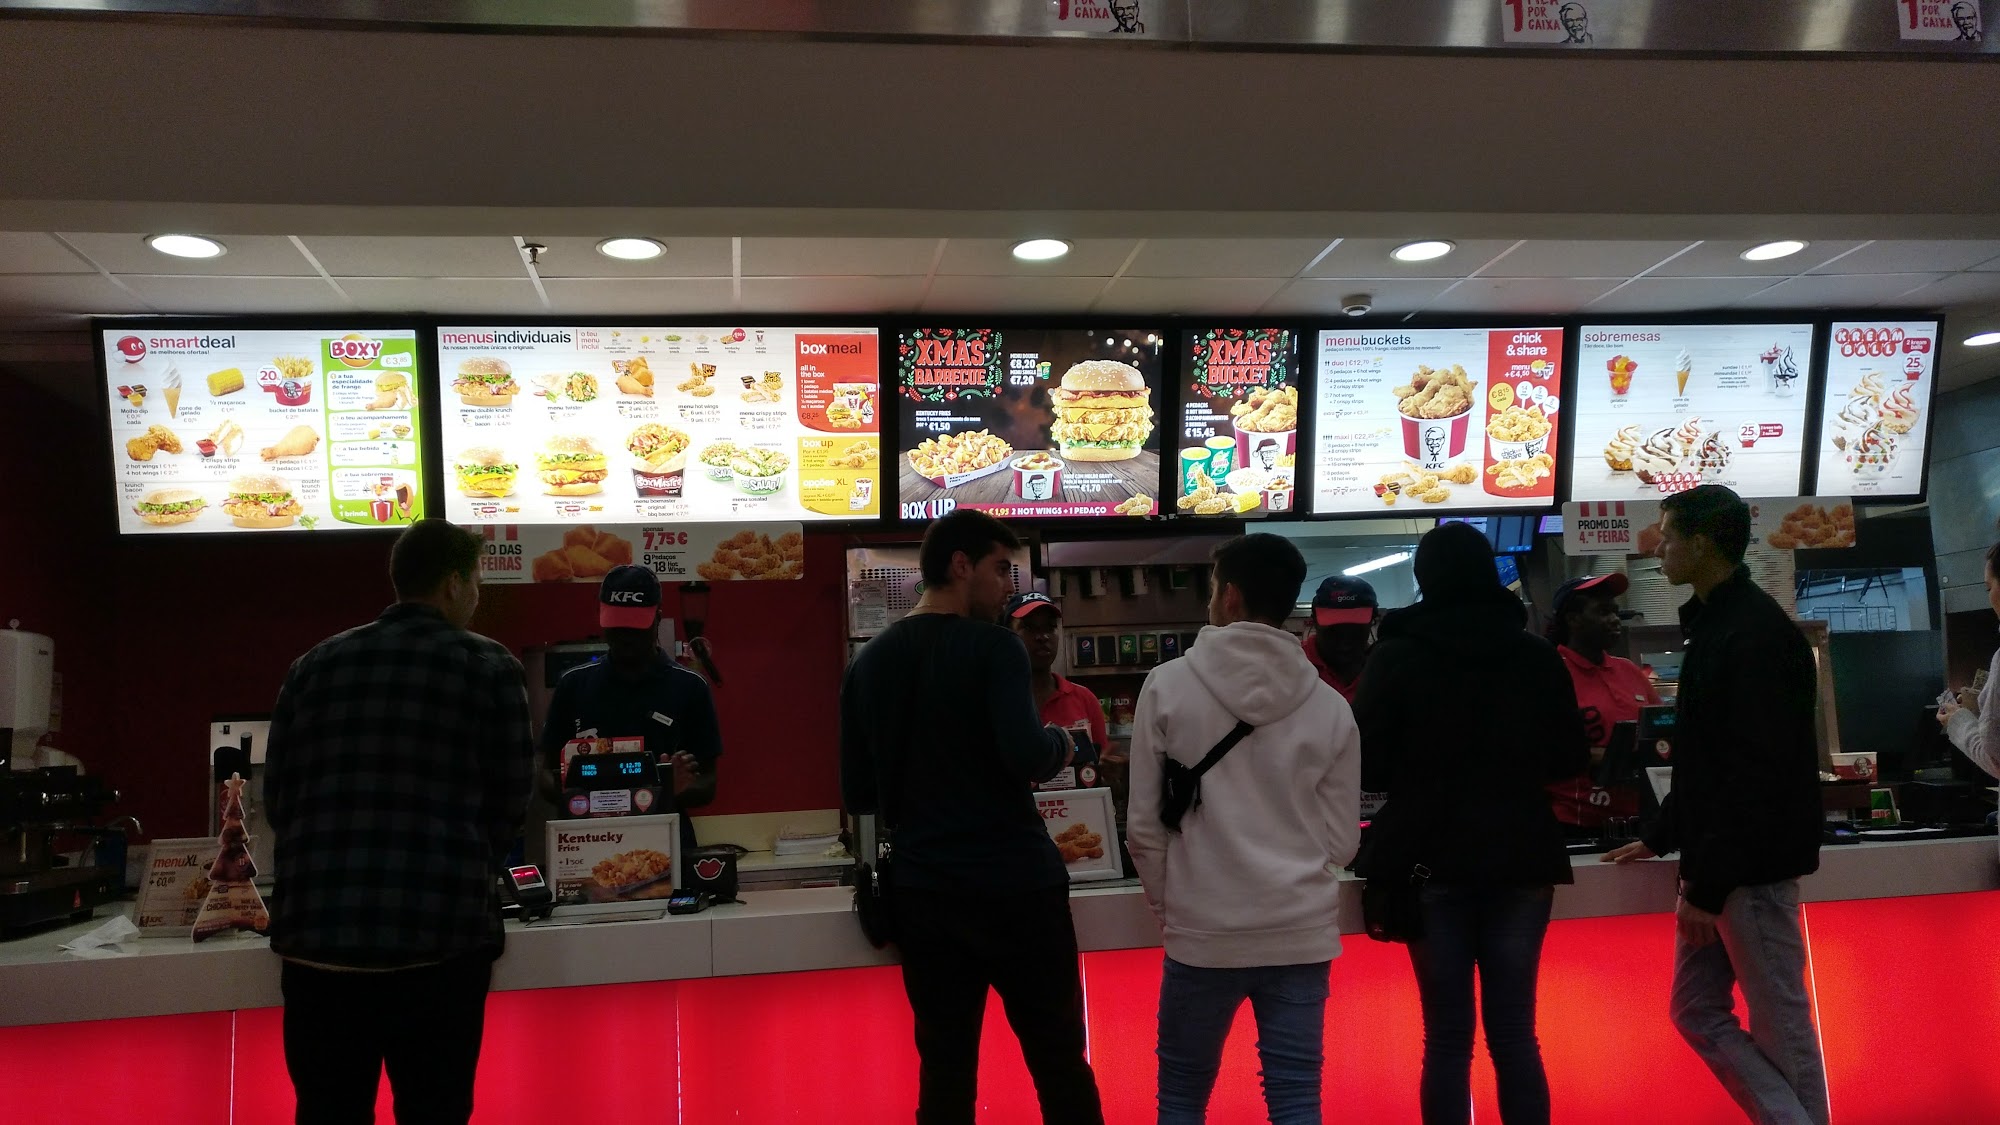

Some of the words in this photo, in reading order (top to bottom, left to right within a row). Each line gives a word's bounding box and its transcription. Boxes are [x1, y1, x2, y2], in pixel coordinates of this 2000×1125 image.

[1528, 7, 1548, 18] POR
[443, 330, 572, 345] menusindividuais
[1325, 334, 1411, 346] menubuckets
[1512, 332, 1542, 344] chick
[1584, 330, 1661, 343] sobremesas
[1837, 329, 1903, 343] KREAM
[149, 335, 236, 350] smartdeal
[800, 341, 862, 355] boxmeal
[331, 341, 382, 357] BOXY
[917, 339, 986, 366] XMAS
[1208, 339, 1272, 365] XMAS
[1516, 345, 1548, 356] share
[1843, 343, 1894, 355] BALL
[1511, 363, 1531, 371] menu
[914, 368, 987, 386] BARBECUE
[1208, 364, 1271, 385] BUCKET
[1424, 462, 1445, 470] KFC
[1654, 474, 1702, 483] KREAM
[902, 501, 929, 520] BOX
[1018, 506, 1035, 515] HOT
[1036, 506, 1063, 515] WINGS
[1075, 505, 1108, 518] PEDAÇO
[1577, 519, 1610, 531] PROMO
[1611, 519, 1629, 530] DAS
[1596, 530, 1629, 544] FEIRAS
[499, 544, 523, 556] DAS
[644, 555, 652, 565] 9
[652, 553, 678, 561] Pedaços
[654, 561, 668, 573] 18
[609, 591, 645, 603] KFC
[1337, 594, 1356, 603] good
[557, 831, 624, 845] Kentucky
[557, 844, 581, 853] Fries
[153, 854, 199, 869] menuXL
